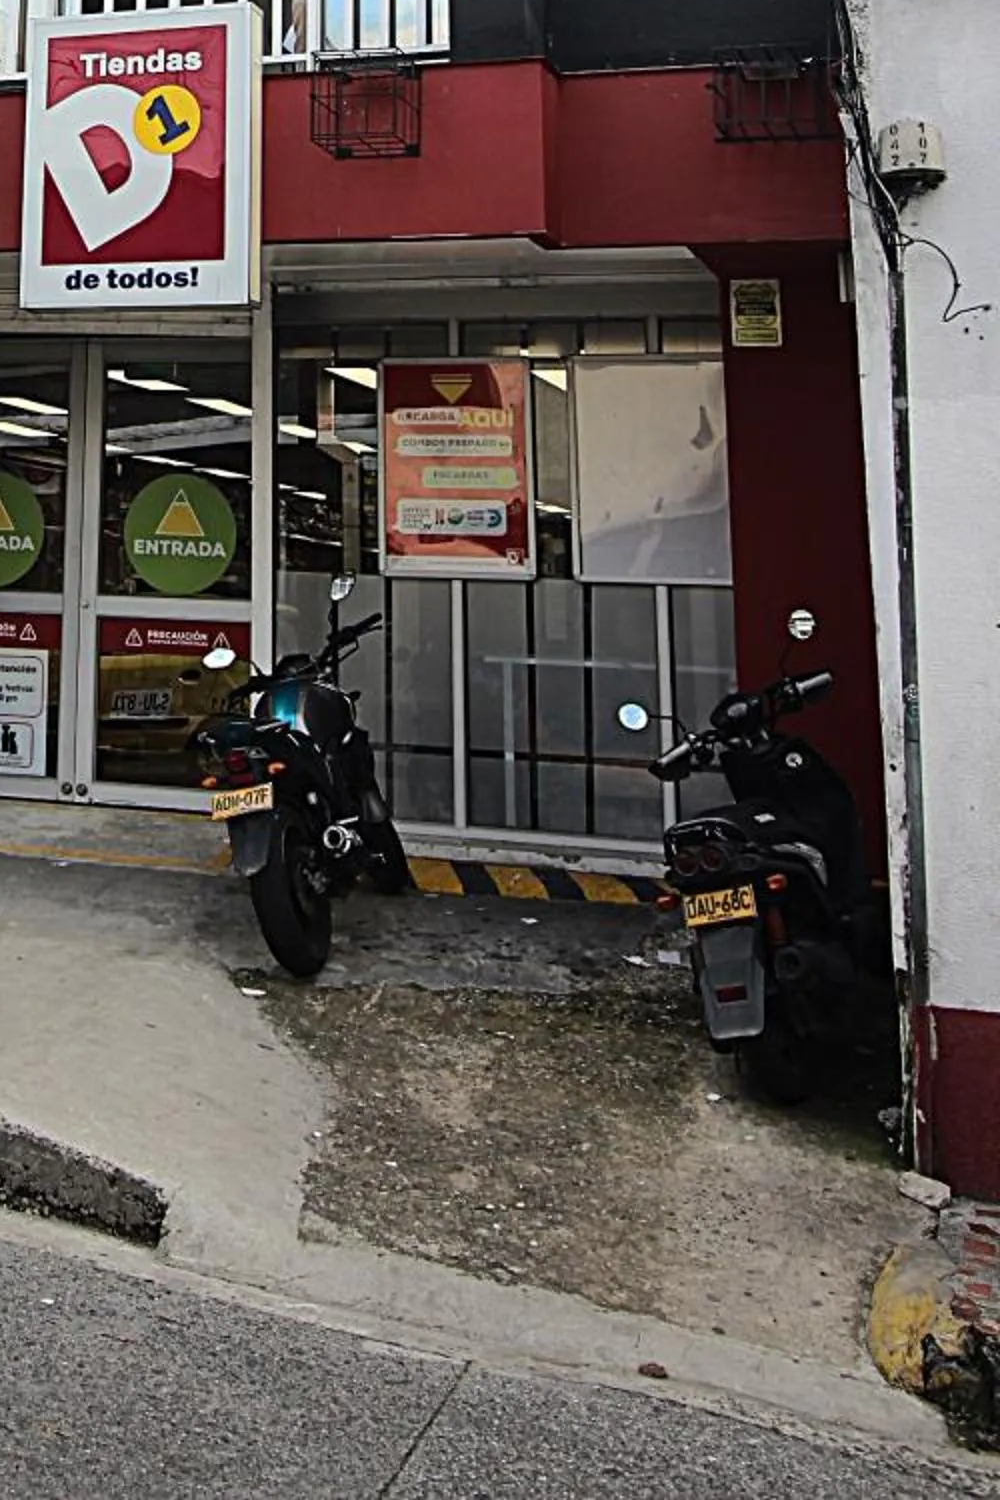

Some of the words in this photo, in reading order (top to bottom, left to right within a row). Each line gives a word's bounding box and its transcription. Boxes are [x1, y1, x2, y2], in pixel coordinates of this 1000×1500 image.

[79, 48, 202, 78] Tiendas
[65, 270, 100, 290] de
[107, 267, 199, 289] todos!
[134, 539, 227, 557] ENTRADA
[147, 630, 209, 641] PRECAUCIÓN
